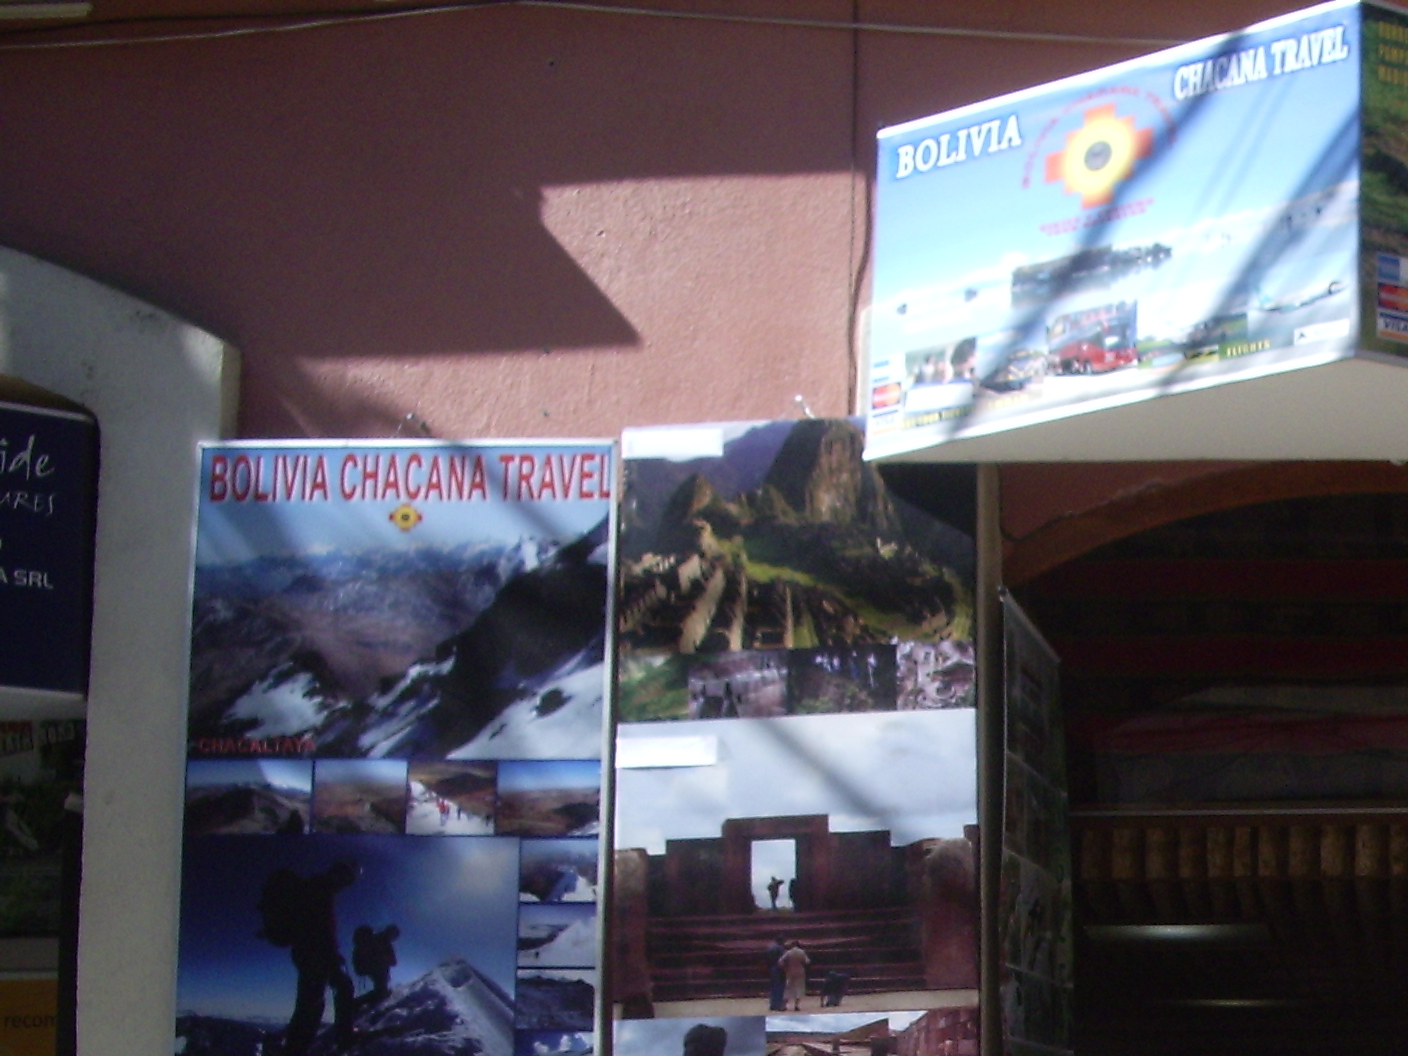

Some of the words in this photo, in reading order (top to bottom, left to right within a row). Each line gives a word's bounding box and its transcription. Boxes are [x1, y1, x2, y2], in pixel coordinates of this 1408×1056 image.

[1173, 46, 1267, 101] CHACANA
[1271, 25, 1350, 75] TRAVEL
[896, 114, 1022, 180] BOLIVIA
[1382, 320, 1408, 333] VISA
[1226, 338, 1271, 358] FLIGHTS
[210, 454, 330, 502] BOLIVIA
[340, 454, 487, 501] CHACANA
[500, 453, 611, 500] TRAVEL
[14, 569, 54, 589] SRL
[199, 737, 317, 753] CHACALTAYA
